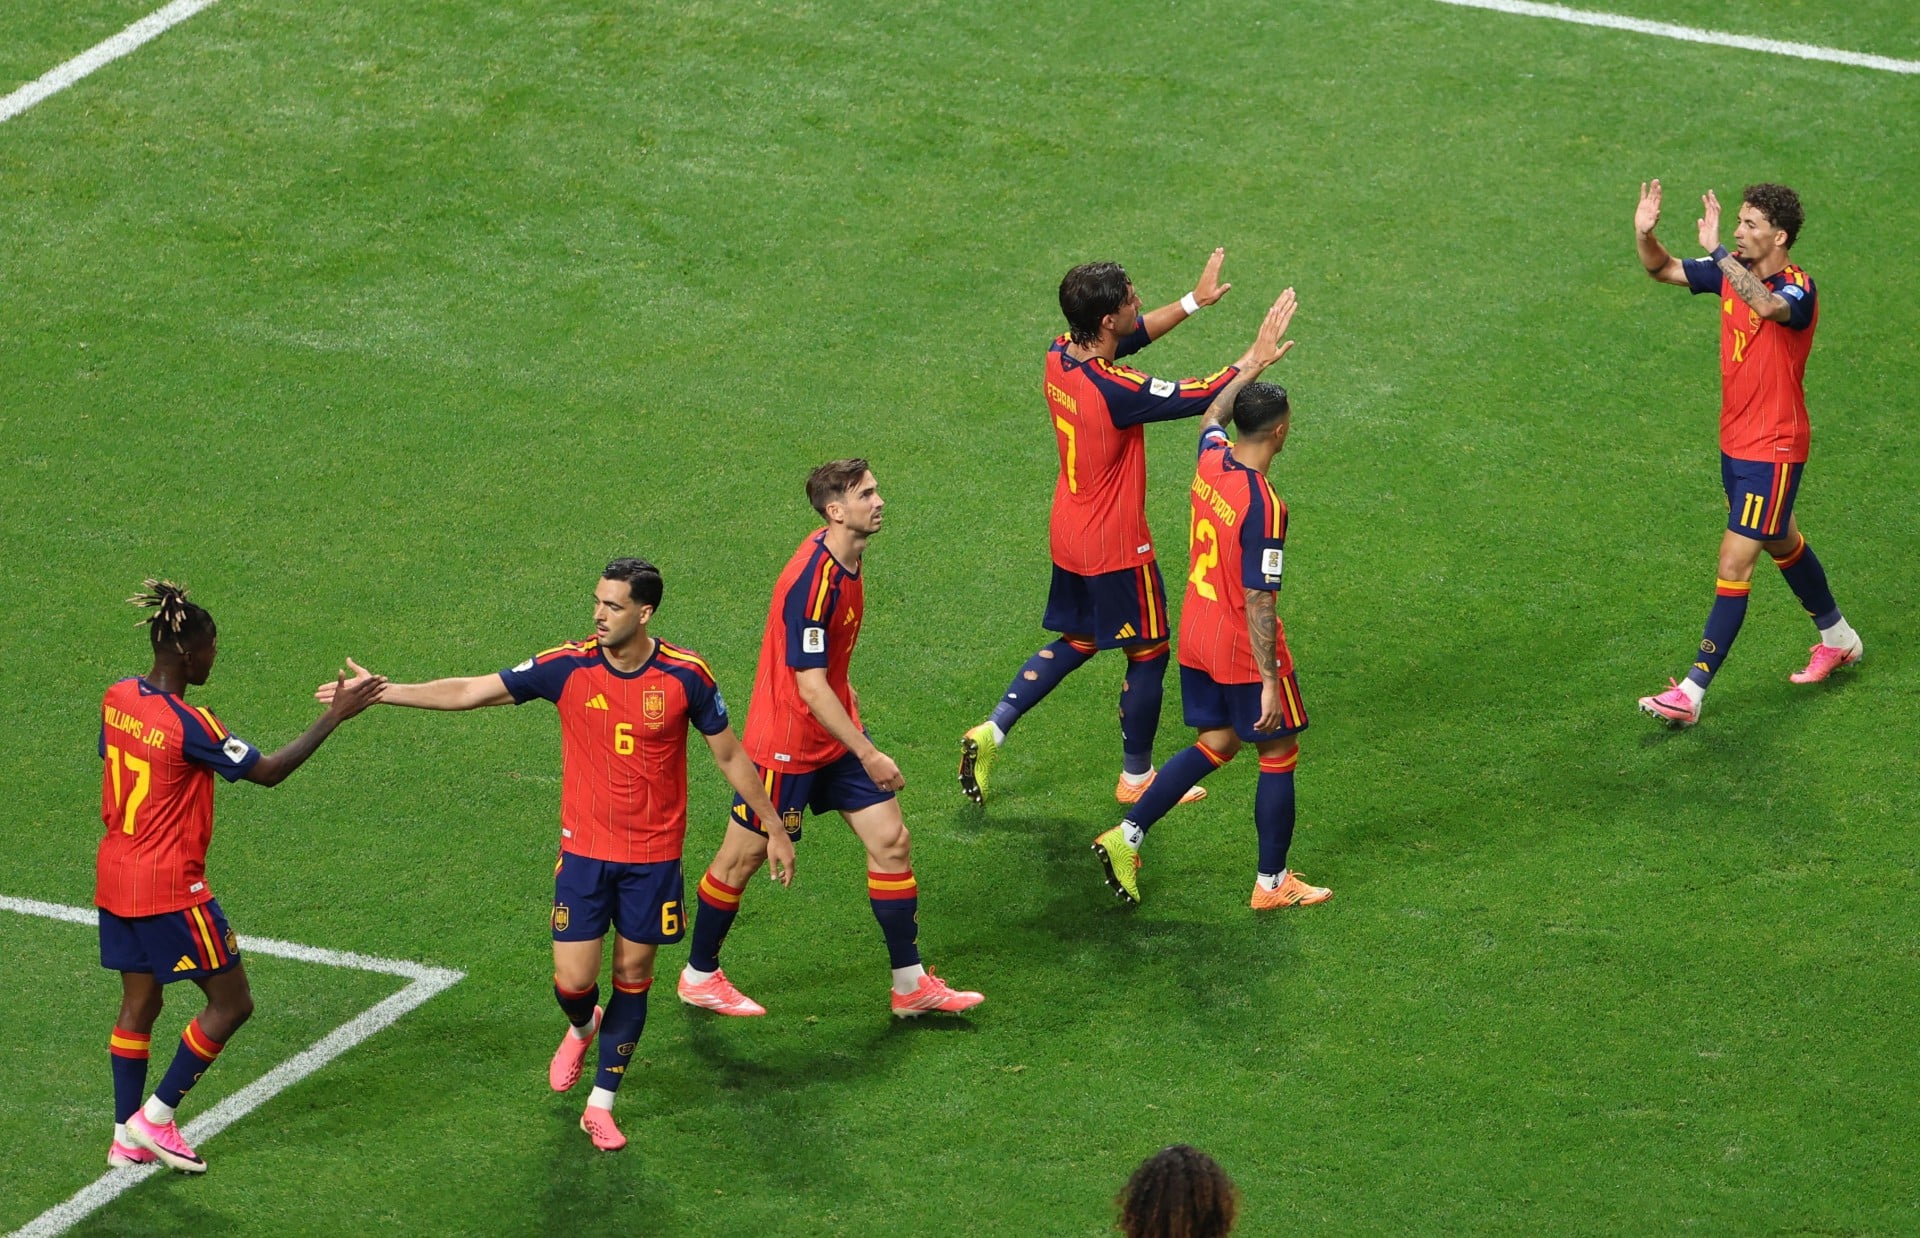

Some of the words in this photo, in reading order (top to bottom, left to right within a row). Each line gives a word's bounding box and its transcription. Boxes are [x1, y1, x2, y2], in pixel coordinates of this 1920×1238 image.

[1731, 328, 1747, 362] 11
[1047, 381, 1078, 416] FERRAN
[1056, 415, 1078, 494] 7
[1191, 472, 1212, 502] DRO
[1740, 492, 1764, 529] 11
[104, 704, 144, 739] WILLIAMS
[142, 727, 166, 750] JR.
[614, 722, 635, 755] 6
[106, 744, 151, 835] 17
[661, 900, 678, 936] 6
